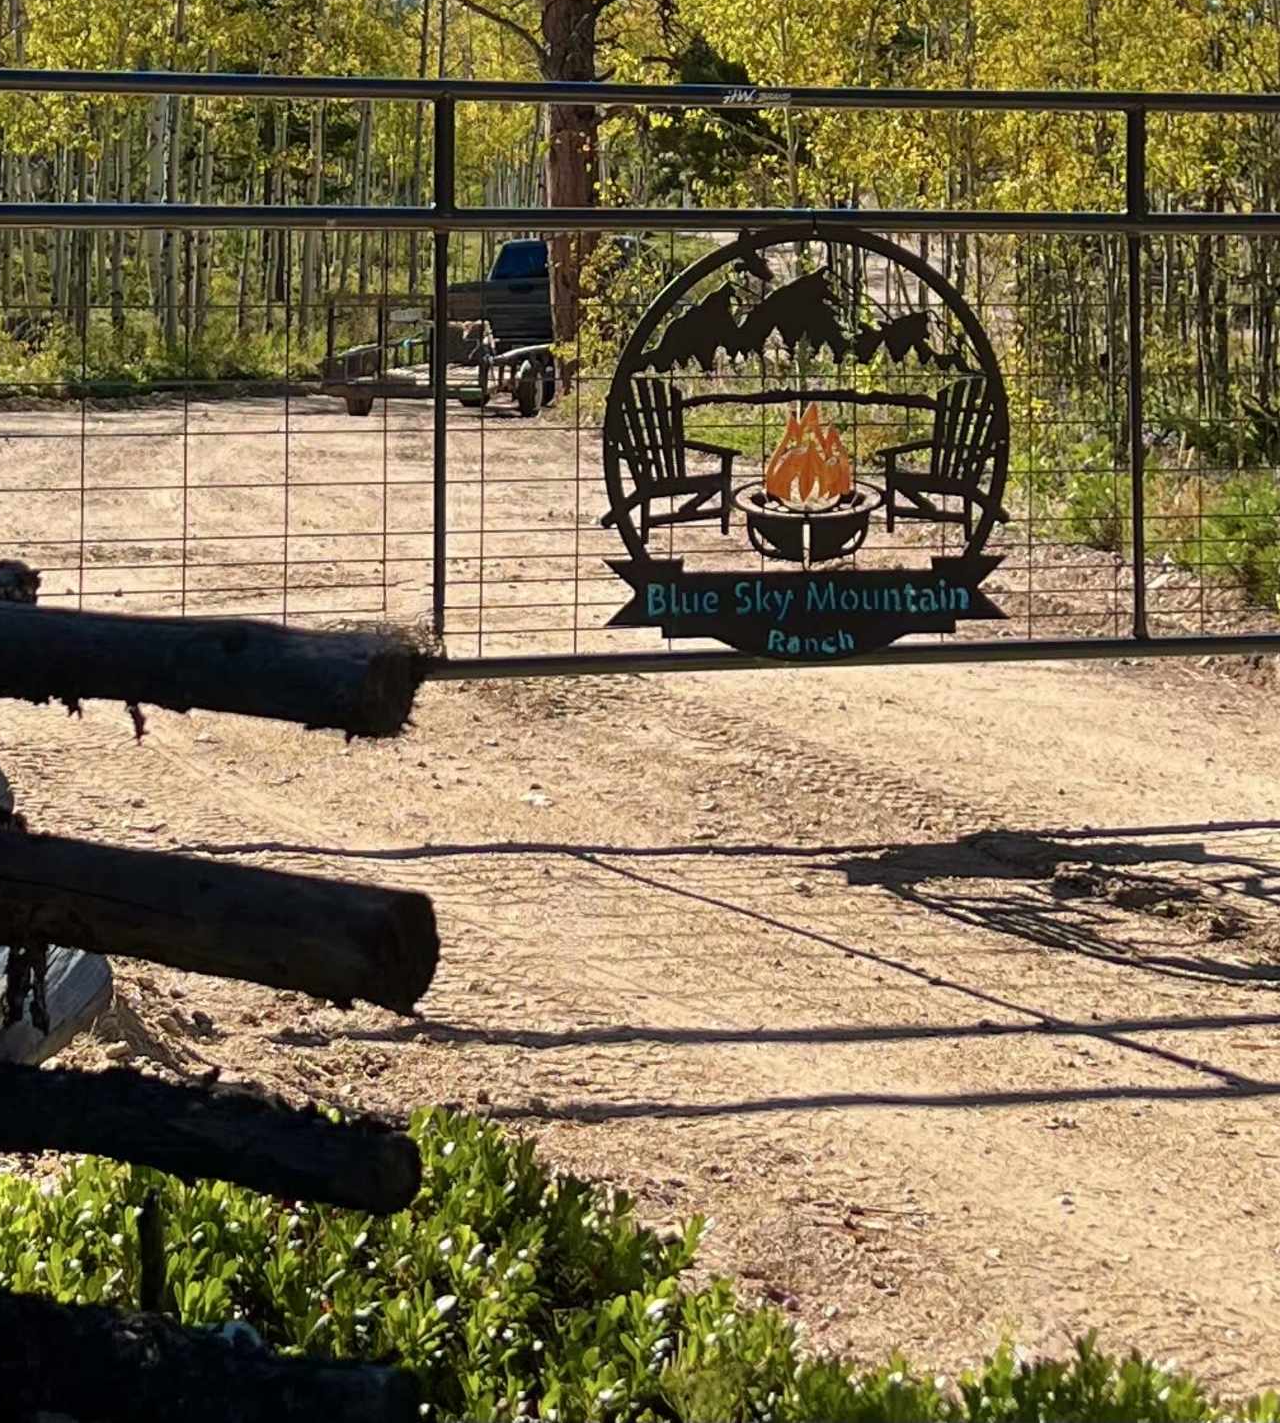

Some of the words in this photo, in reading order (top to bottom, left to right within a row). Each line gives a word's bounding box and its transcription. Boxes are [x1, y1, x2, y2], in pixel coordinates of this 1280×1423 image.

[646, 582, 720, 616] Blue
[735, 578, 795, 621] Sky
[806, 578, 971, 614] Mountain
[767, 628, 856, 654] Ranch
